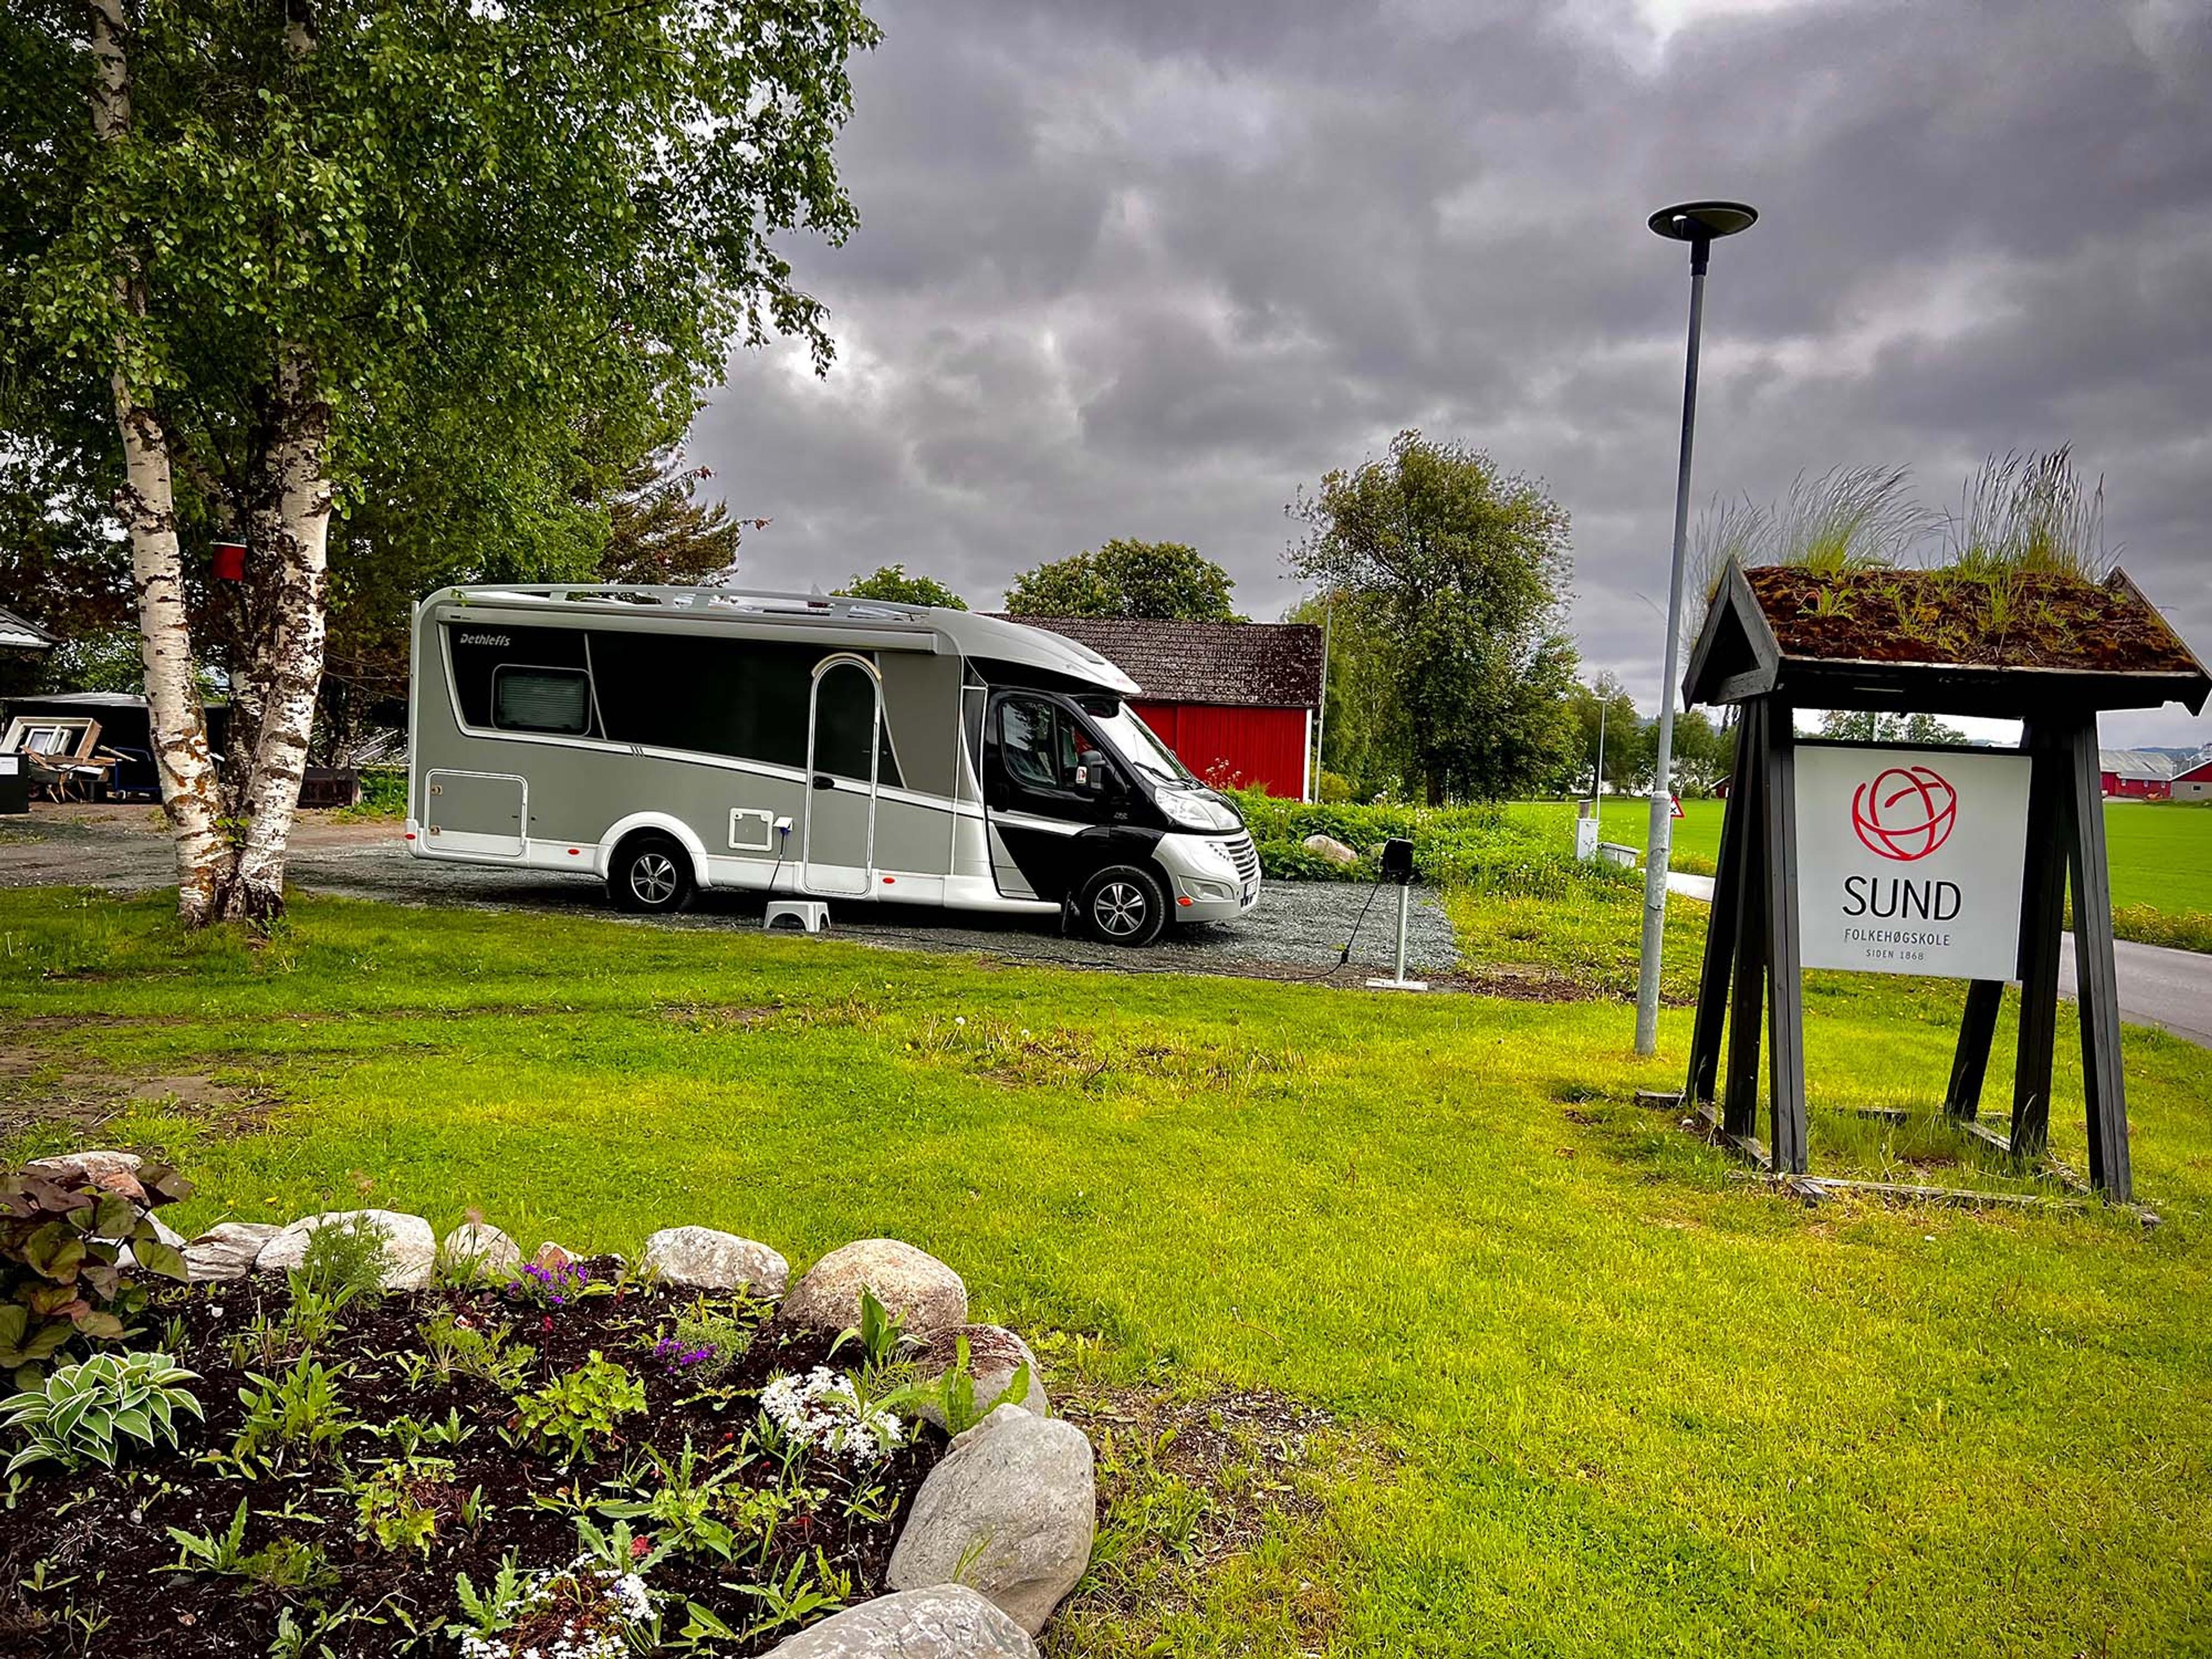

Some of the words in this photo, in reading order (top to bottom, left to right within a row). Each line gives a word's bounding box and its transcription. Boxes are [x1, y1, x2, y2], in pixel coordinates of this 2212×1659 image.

[460, 633, 511, 646] Dethleffs
[1842, 876, 1961, 921] SUND
[1844, 929, 1950, 946] FOLKEHØGSKOLE
[1866, 949, 1894, 959] SIDEN
[1900, 951, 1925, 960] 1868
